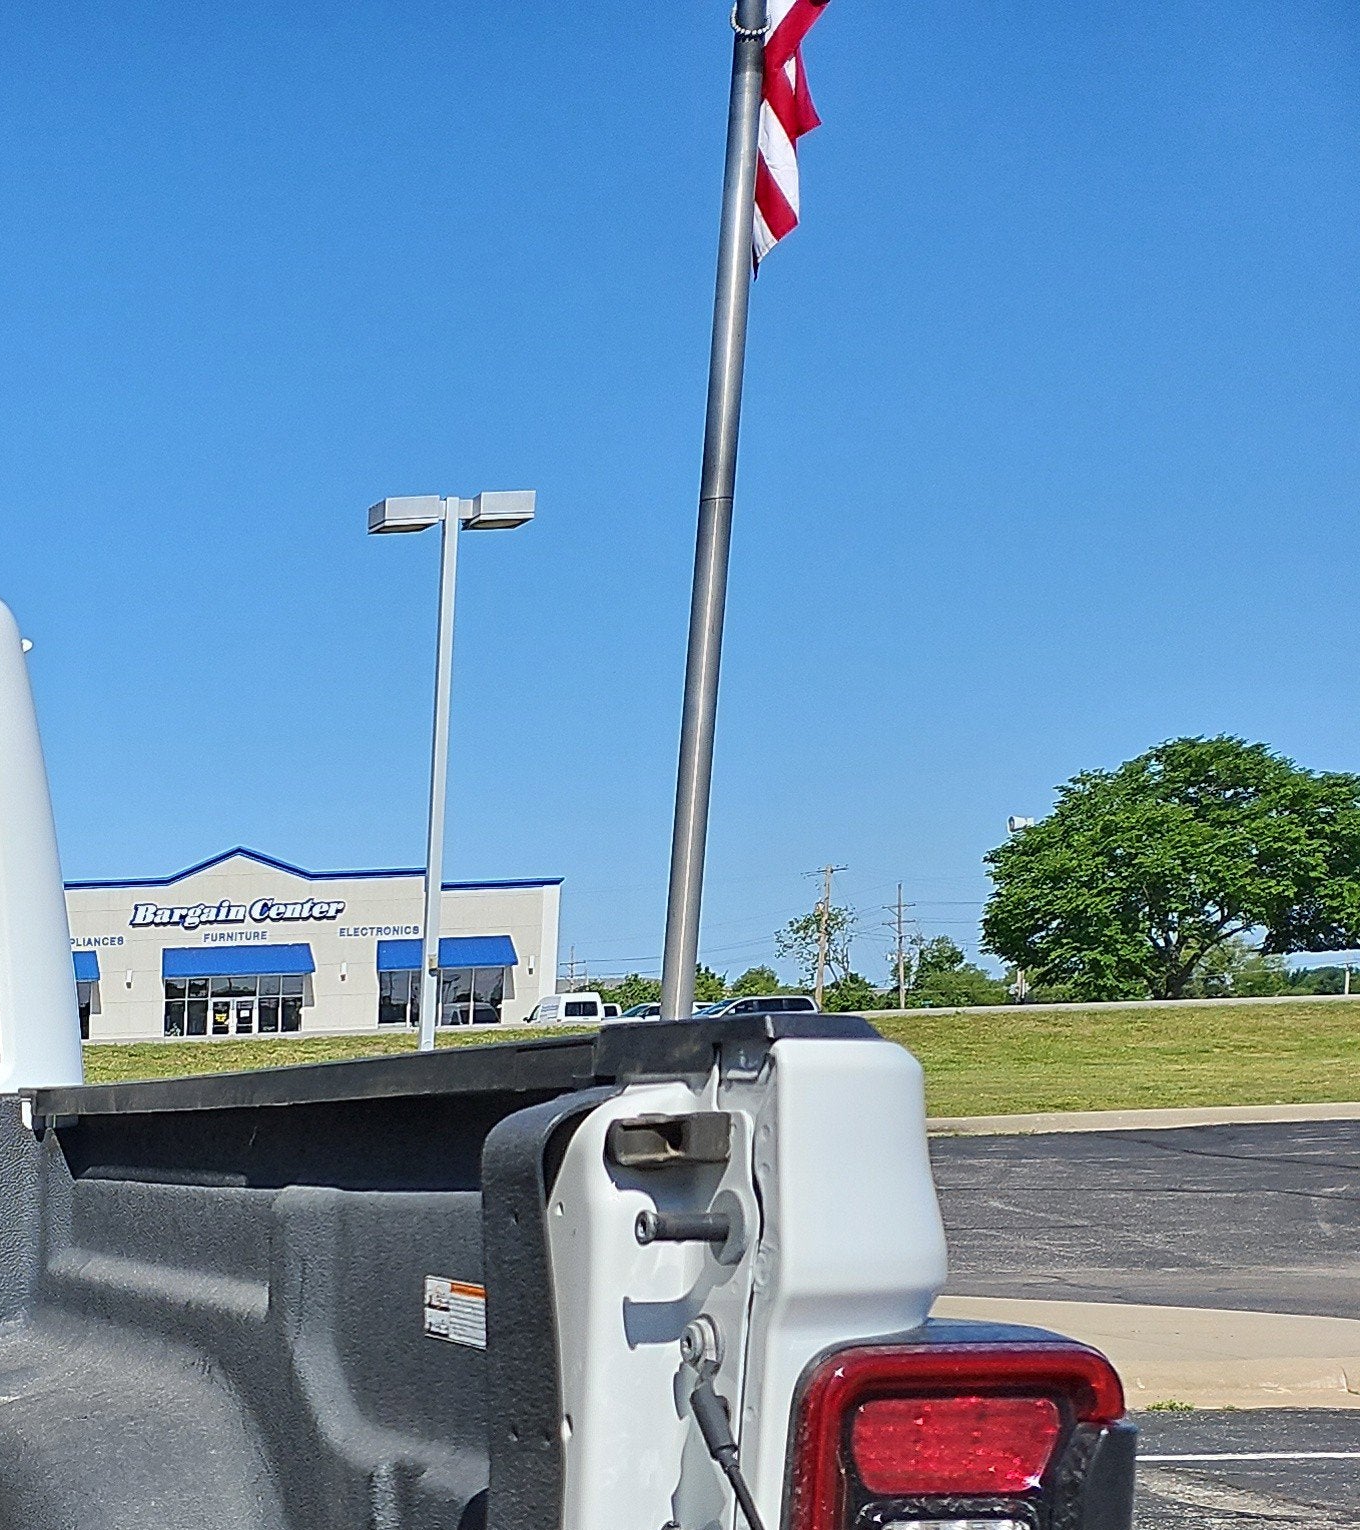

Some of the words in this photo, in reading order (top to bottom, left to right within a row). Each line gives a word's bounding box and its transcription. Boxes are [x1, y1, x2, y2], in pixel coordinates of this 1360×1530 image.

[130, 899, 246, 930] Bargain
[249, 898, 345, 922] Center
[203, 931, 268, 943] FURNITURE
[339, 925, 420, 938] ELECTRONICS
